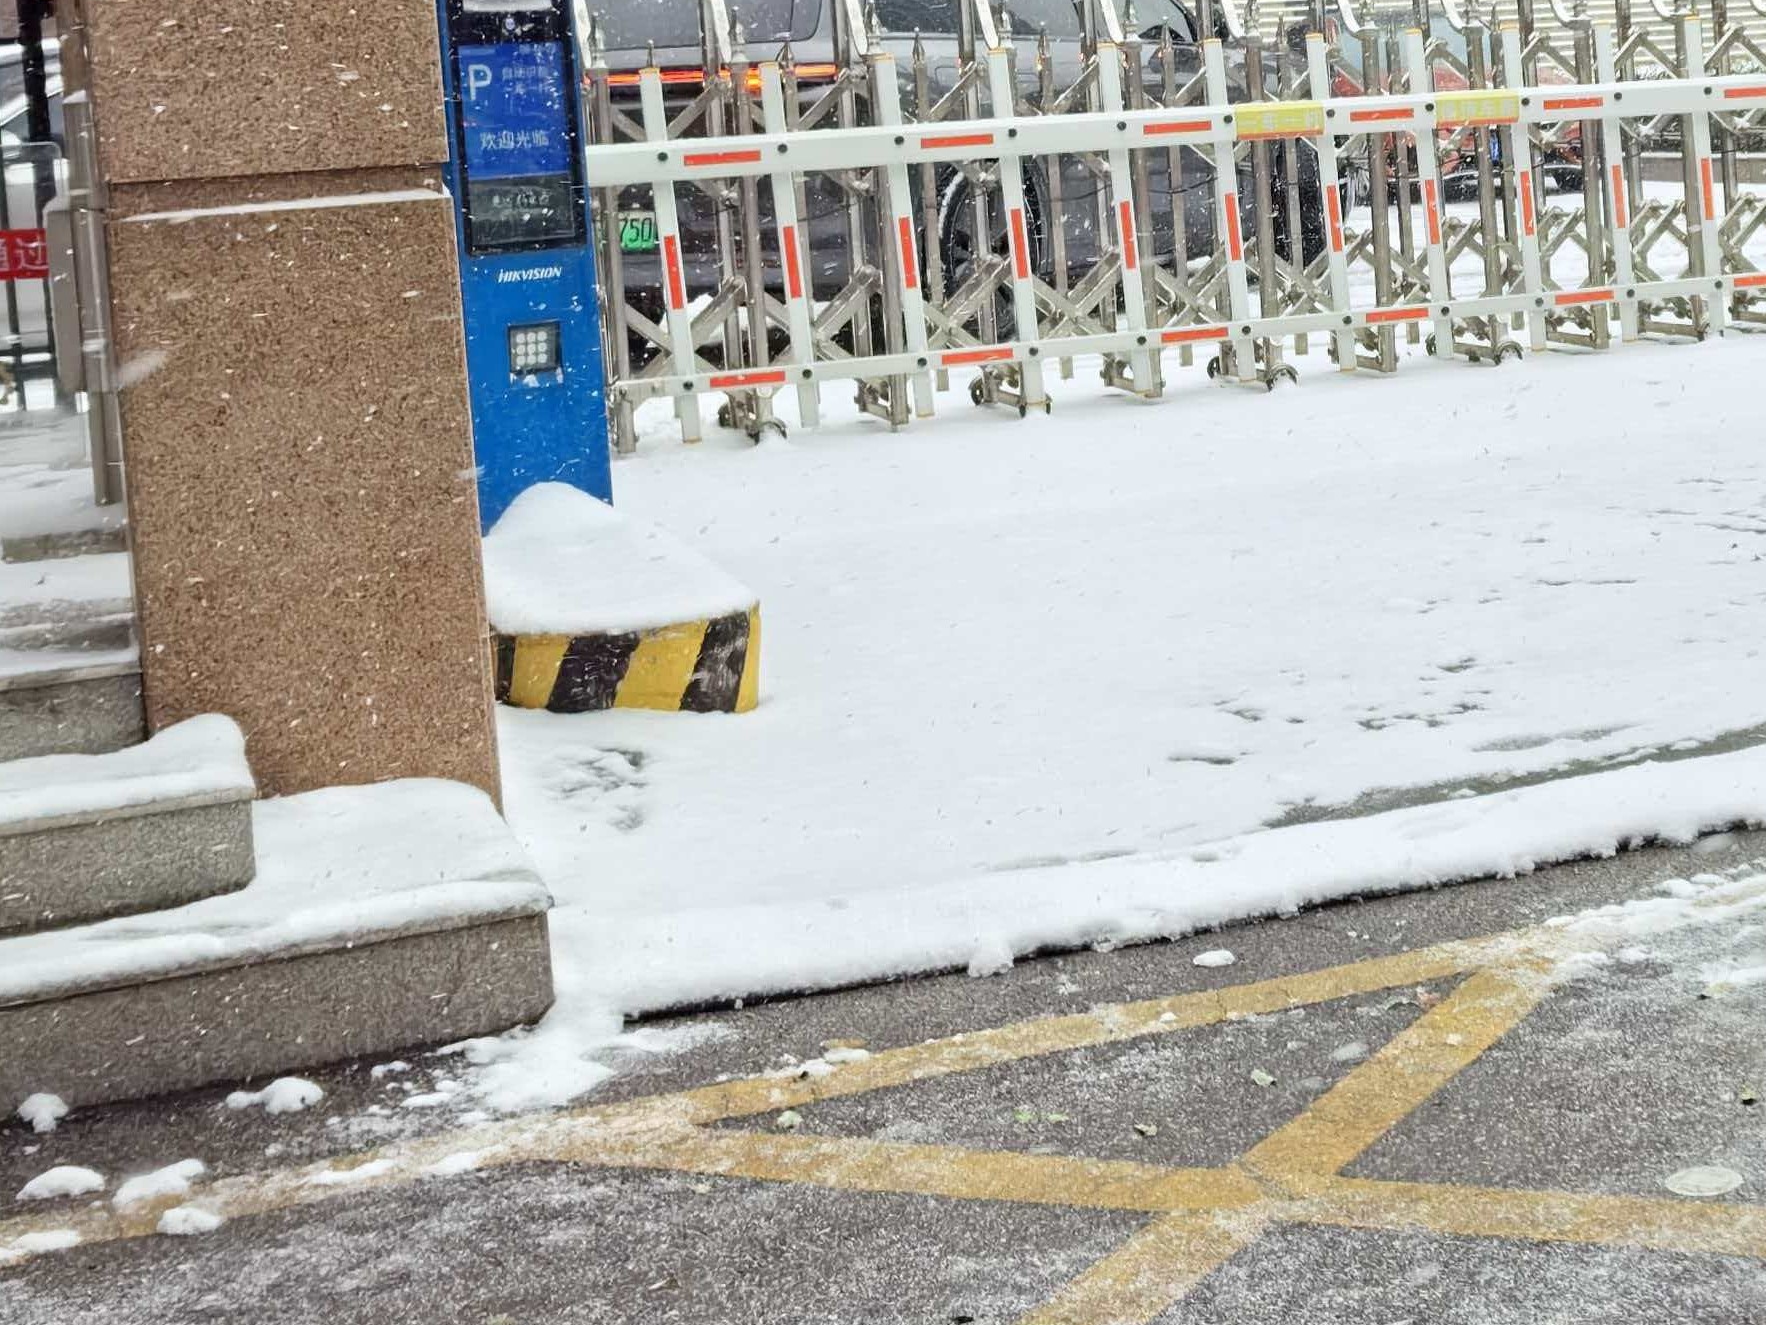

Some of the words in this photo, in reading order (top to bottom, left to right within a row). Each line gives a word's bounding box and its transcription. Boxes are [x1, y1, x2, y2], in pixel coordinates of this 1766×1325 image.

[468, 64, 493, 100] P
[480, 130, 550, 150] 欢迎光临
[498, 267, 562, 283] HIKVISION
